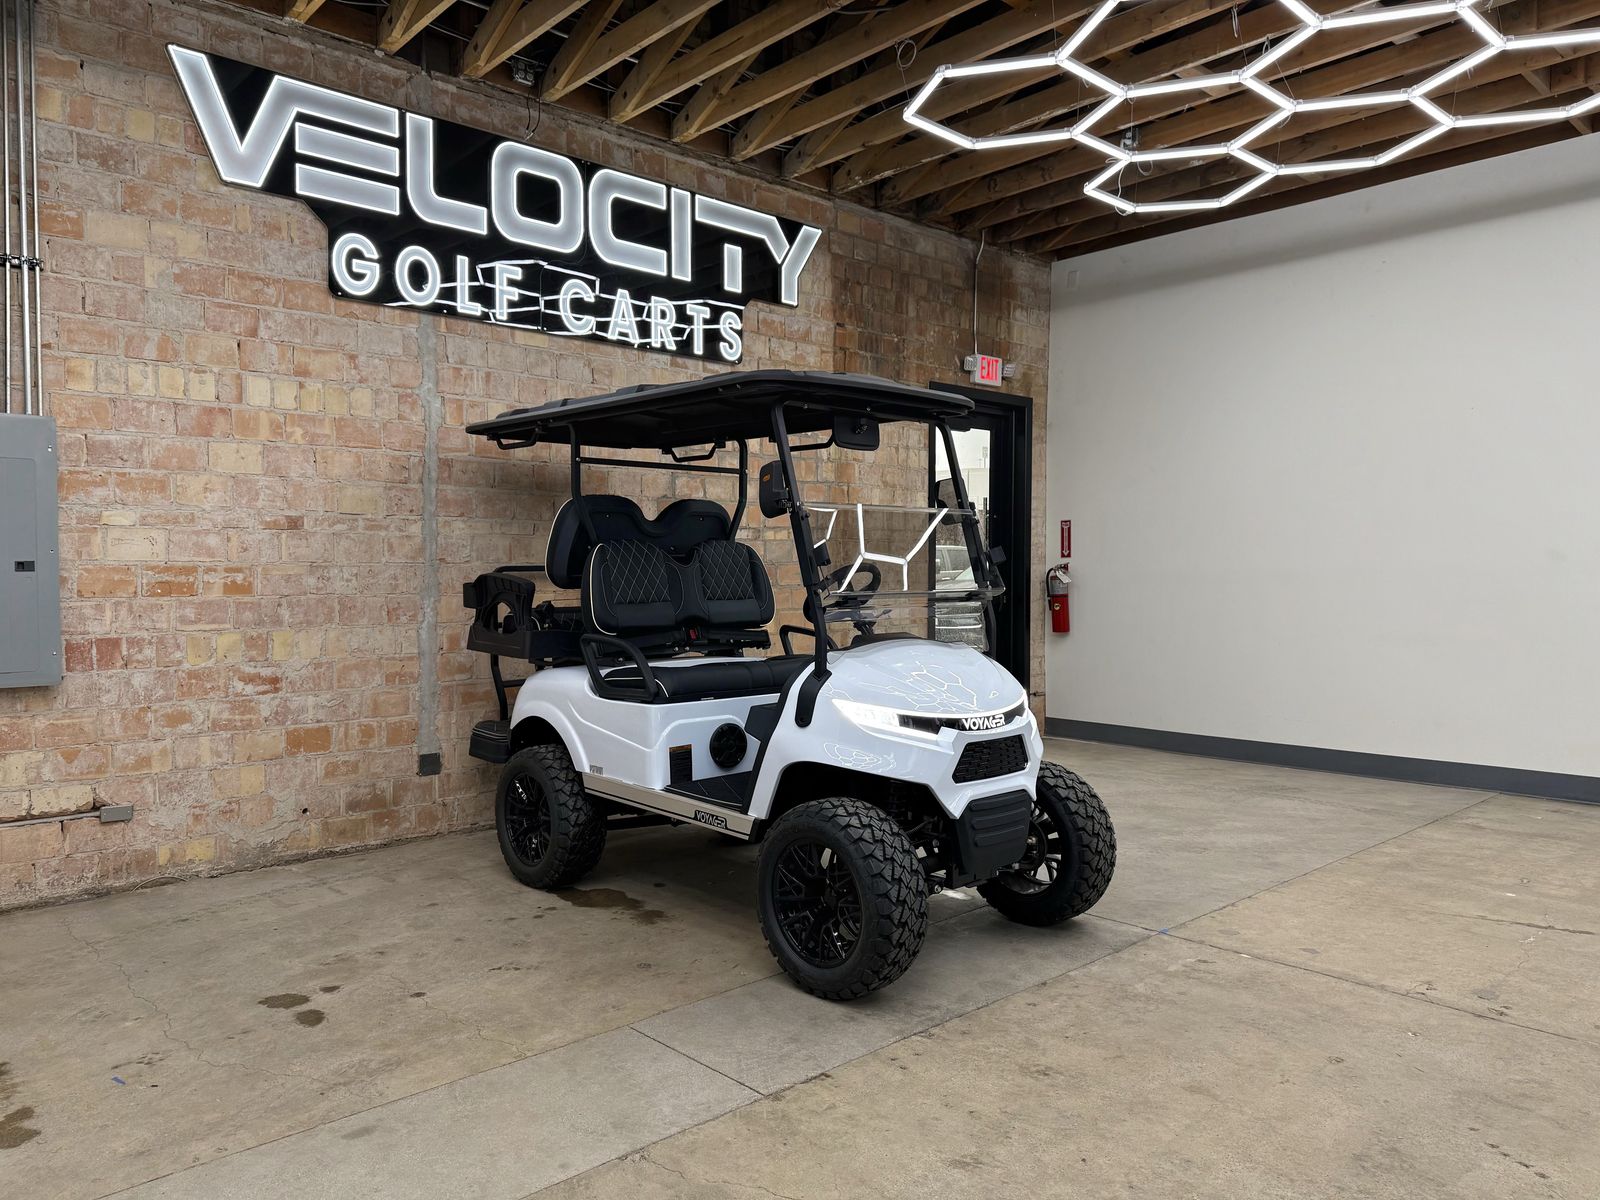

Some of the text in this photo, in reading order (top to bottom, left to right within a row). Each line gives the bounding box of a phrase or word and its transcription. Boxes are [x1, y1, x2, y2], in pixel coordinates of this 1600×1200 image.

[167, 44, 823, 307] VELOCITY
[331, 232, 743, 363] GOLF CARTS
[980, 356, 999, 384] EXIT
[962, 713, 1005, 730] VOYAGER
[696, 810, 726, 829] VOYAGER
